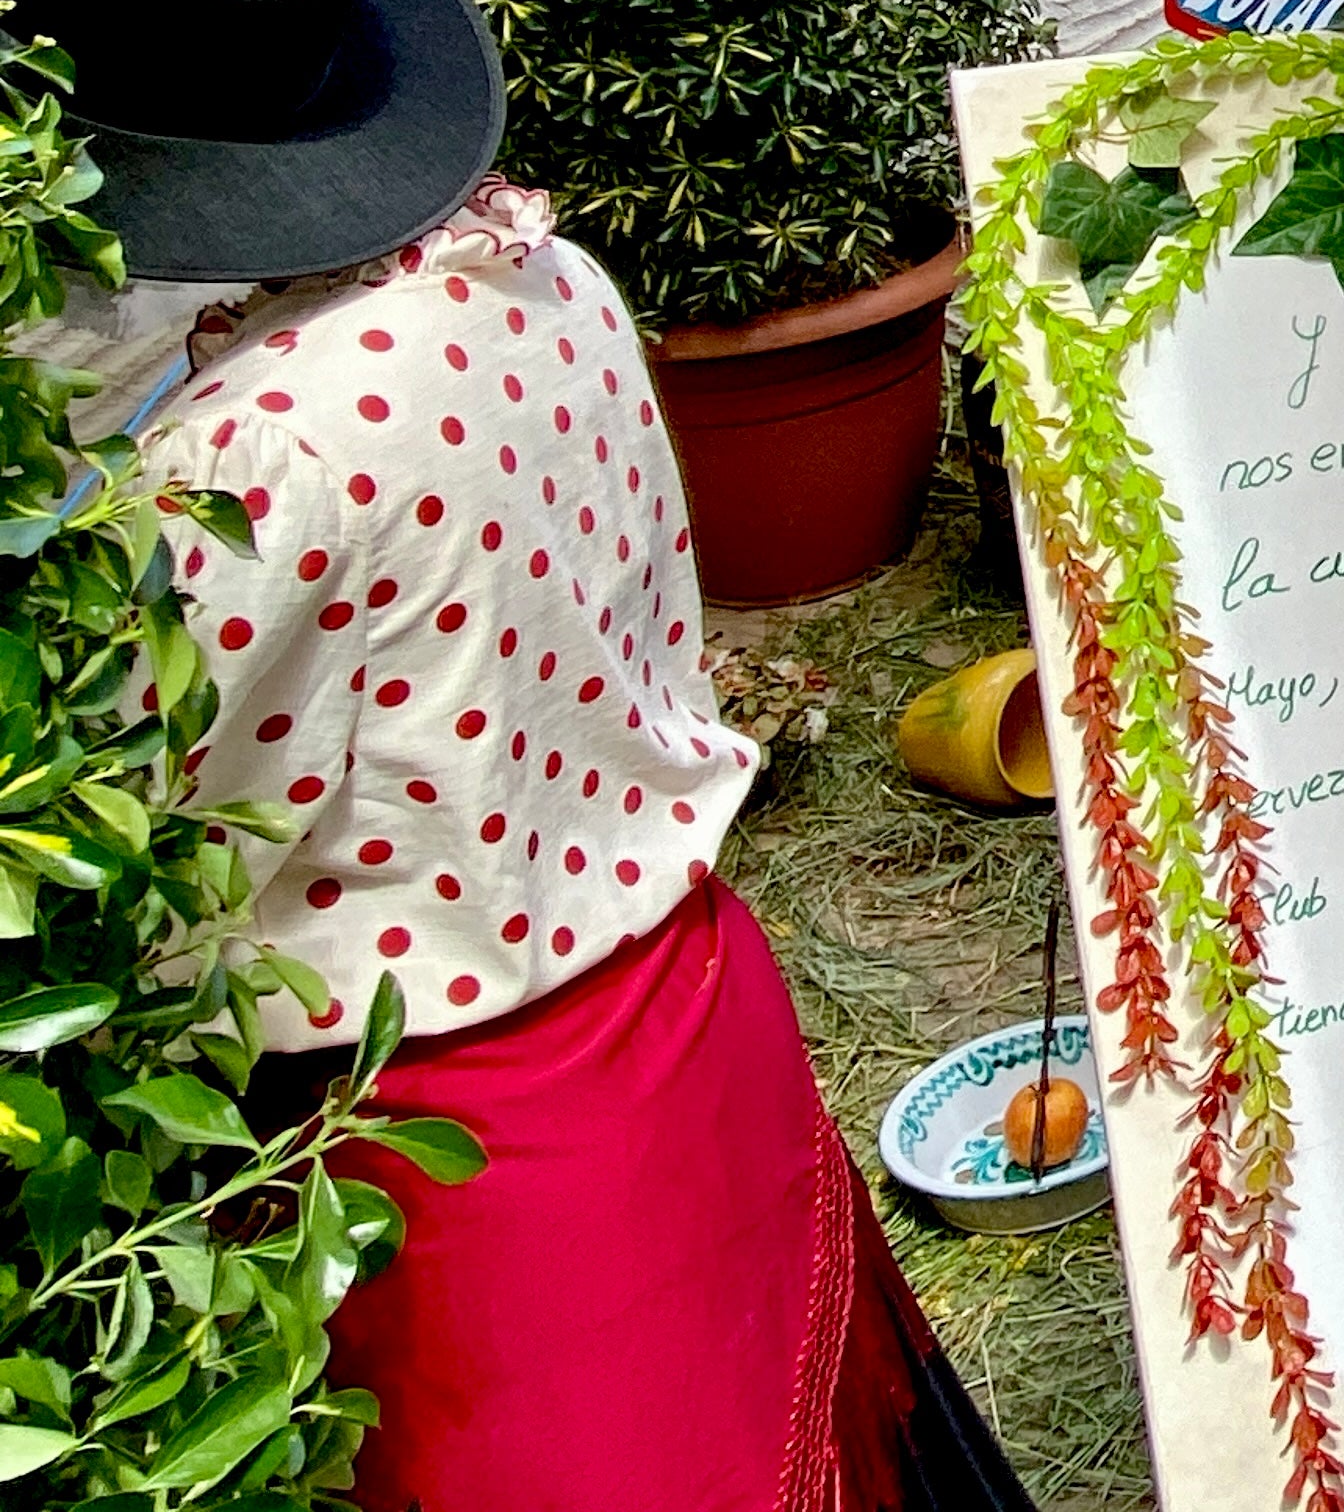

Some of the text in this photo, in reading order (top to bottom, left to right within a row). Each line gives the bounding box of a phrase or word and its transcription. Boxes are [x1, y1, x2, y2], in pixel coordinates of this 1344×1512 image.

[1219, 452, 1293, 492] nos
[1221, 537, 1290, 611] la
[1272, 876, 1326, 926] lub
